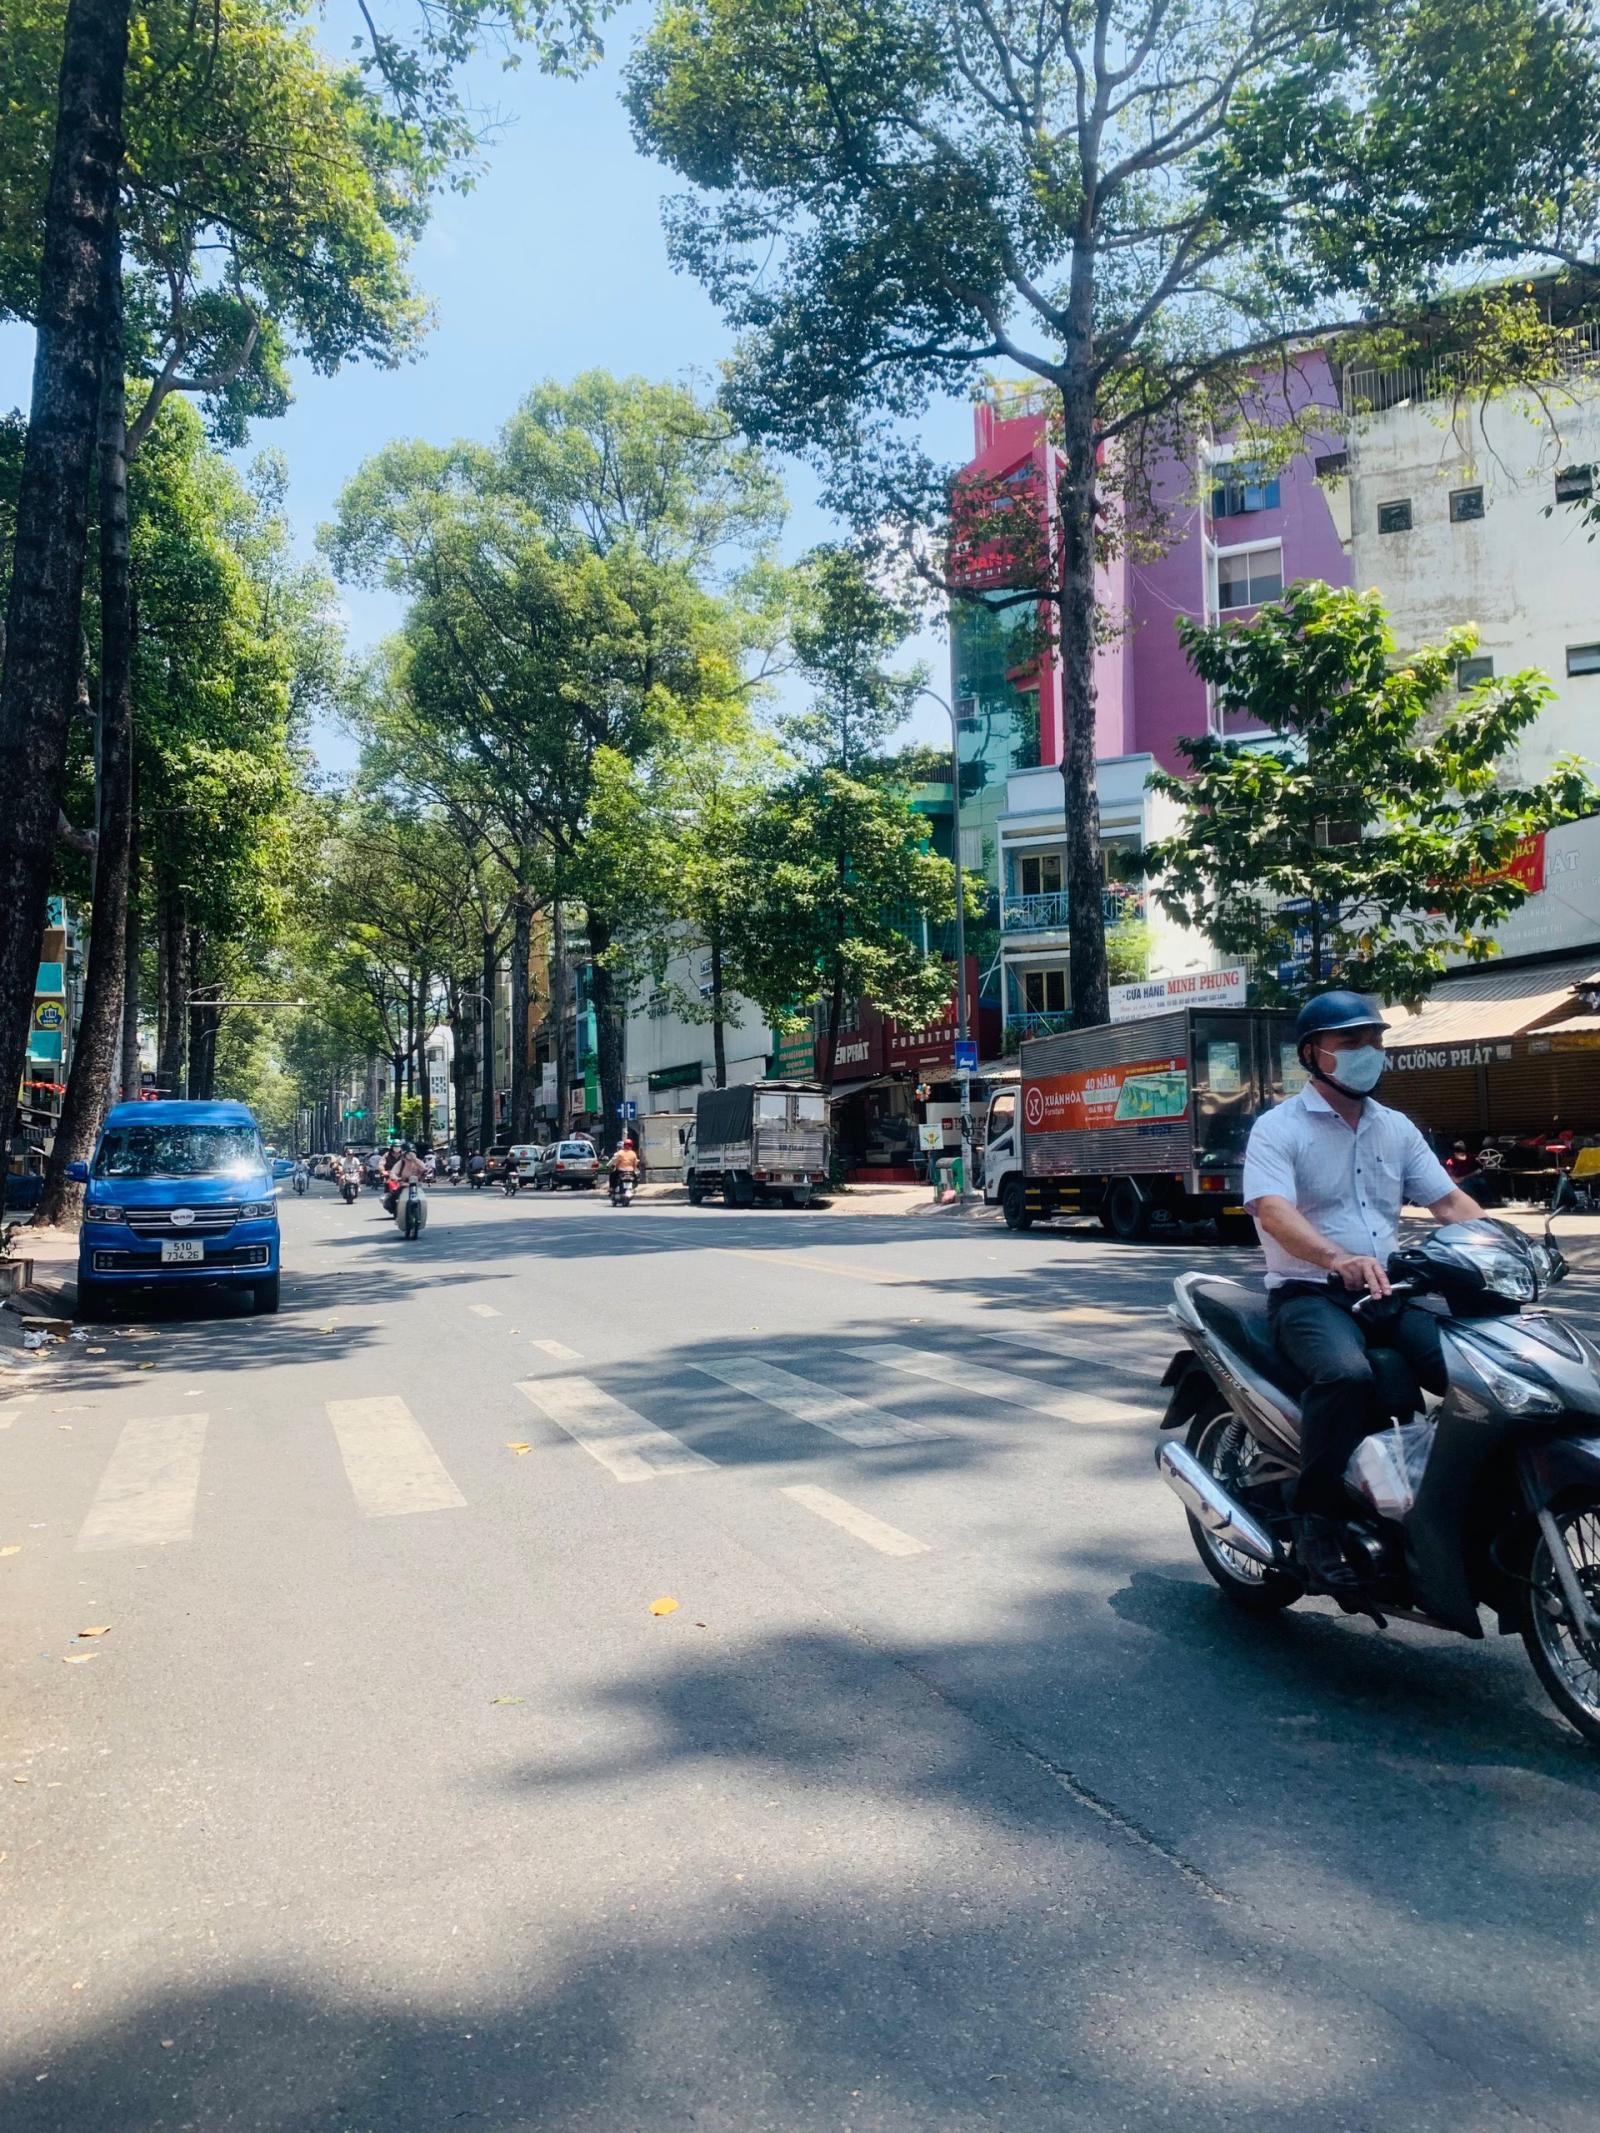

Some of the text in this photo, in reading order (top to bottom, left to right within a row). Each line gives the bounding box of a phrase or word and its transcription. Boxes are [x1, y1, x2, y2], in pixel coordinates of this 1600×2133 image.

[1143, 985, 1164, 999] HÀNG
[1167, 976, 1196, 995] MINH
[1450, 1043, 1494, 1067] PHÁT
[1085, 1079, 1095, 1090] 40
[167, 1251, 199, 1260] 734.26
